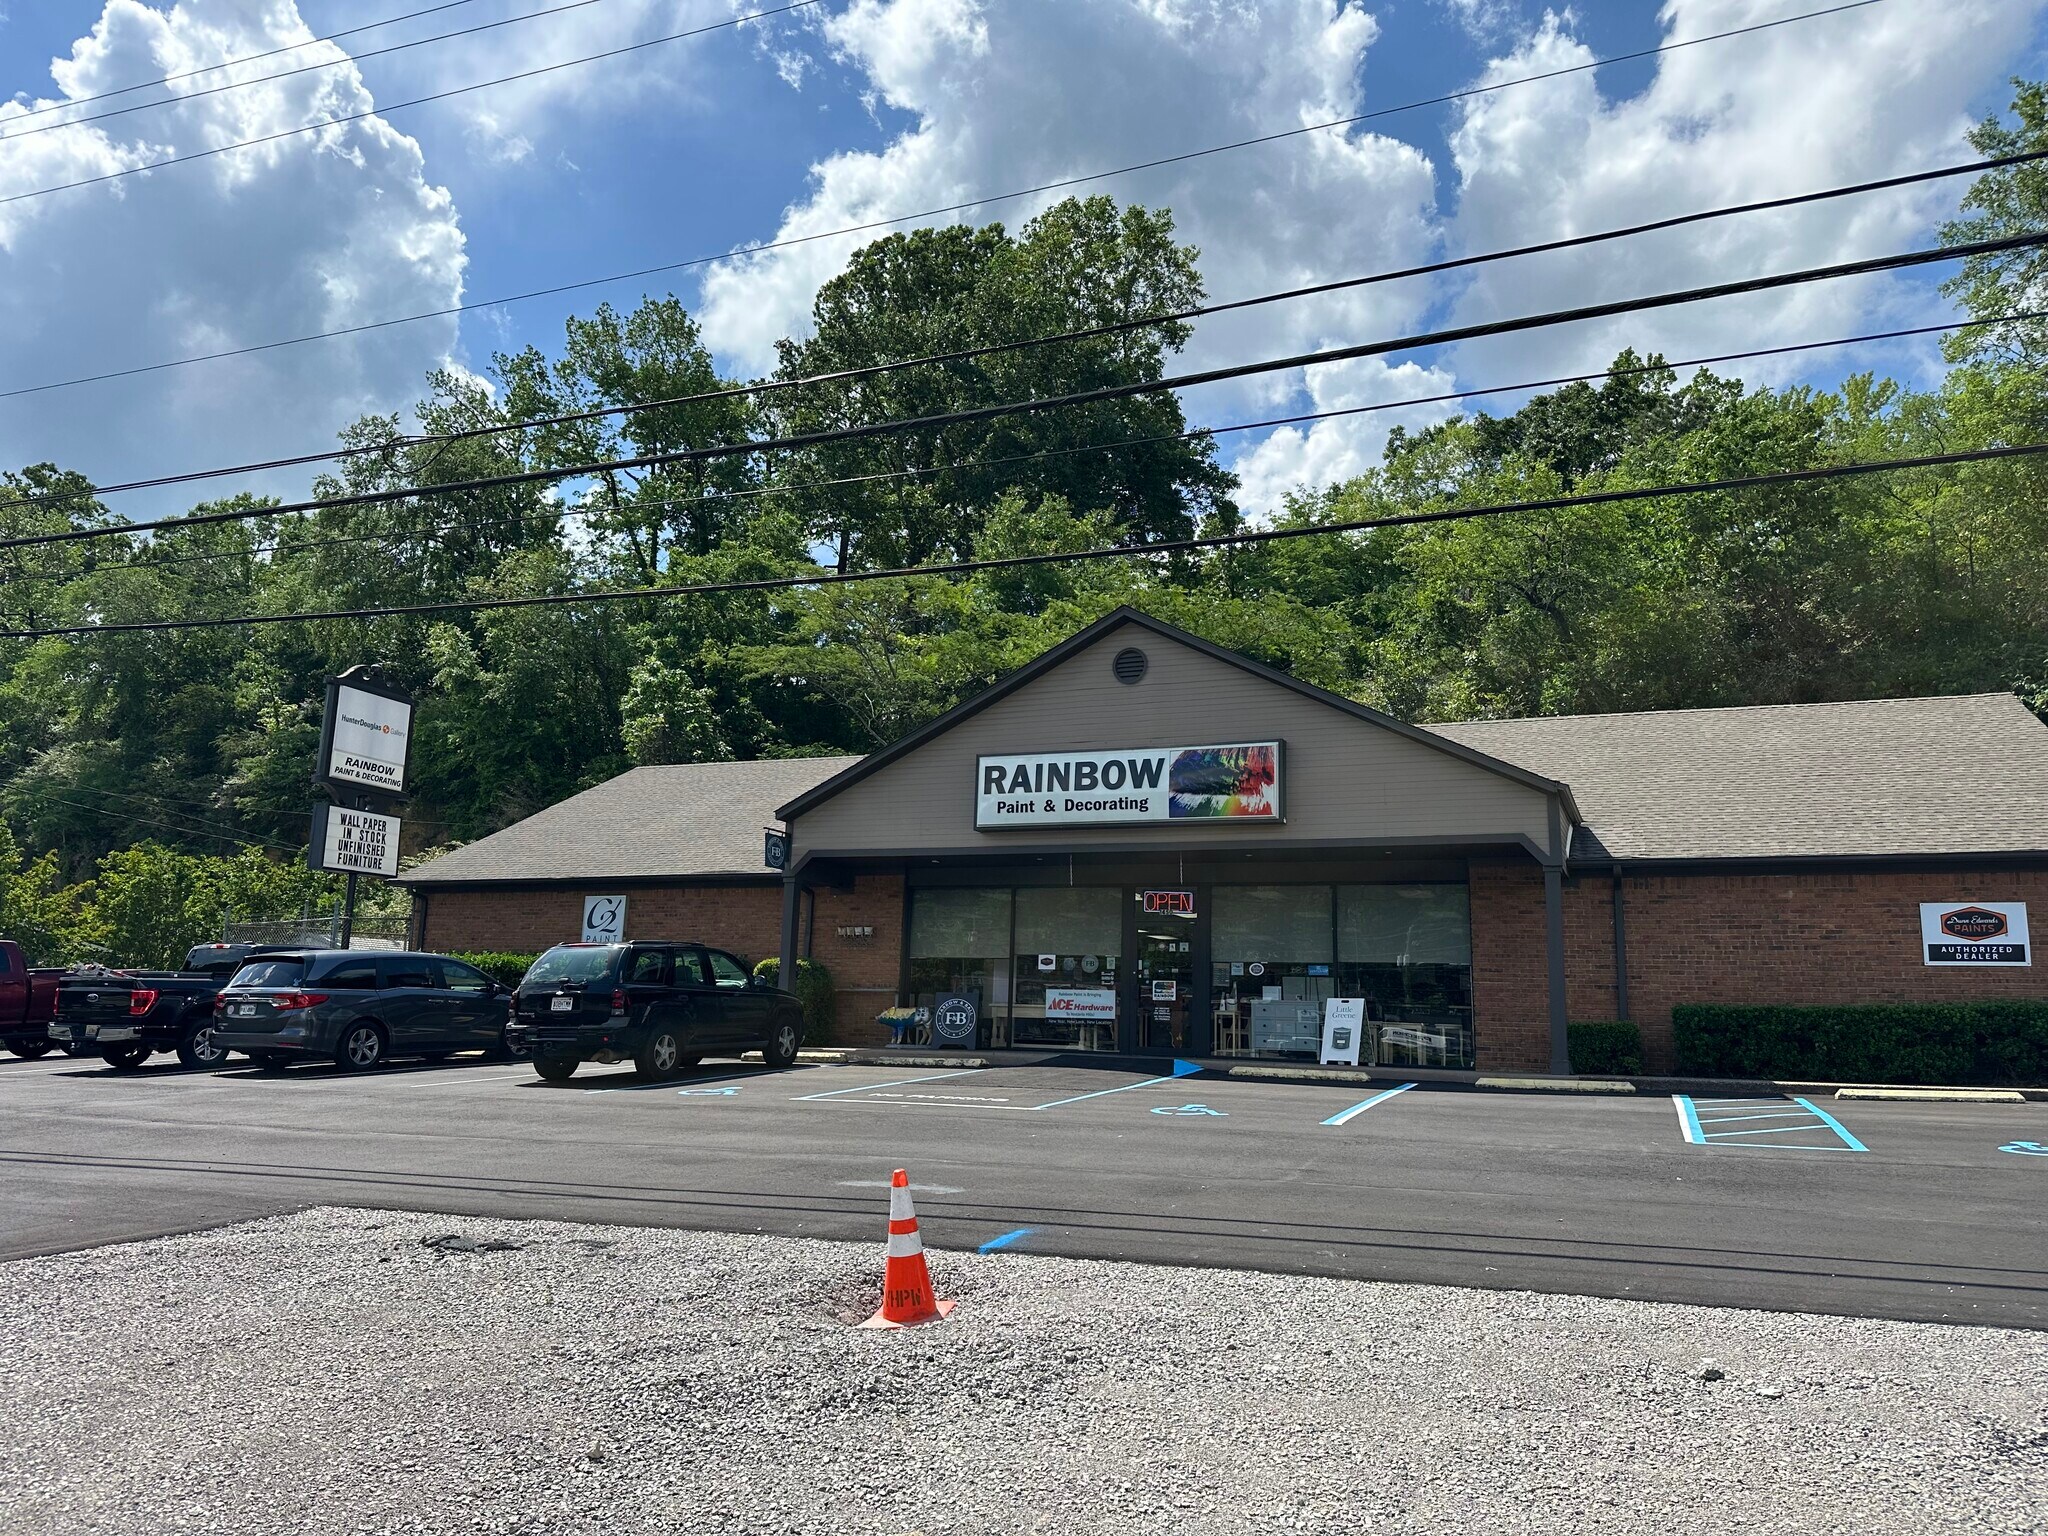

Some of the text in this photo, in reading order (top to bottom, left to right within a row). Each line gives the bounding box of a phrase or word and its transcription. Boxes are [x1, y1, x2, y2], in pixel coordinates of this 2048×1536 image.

[345, 757, 395, 776] RAINBOW
[334, 766, 355, 776] PAINT
[361, 772, 401, 787] DECORATING
[983, 758, 1166, 795] RAINBOW
[997, 797, 1149, 814] Paint & Decorating
[340, 813, 387, 832] WALL PAPER
[343, 827, 387, 845] IN STOCK
[338, 839, 386, 857] UNFINISHED
[337, 853, 383, 869] FURNITURE
[1145, 893, 1192, 912] OPEN
[1954, 924, 1995, 933] PAINTS
[1048, 997, 1114, 1012] ACE Hardware
